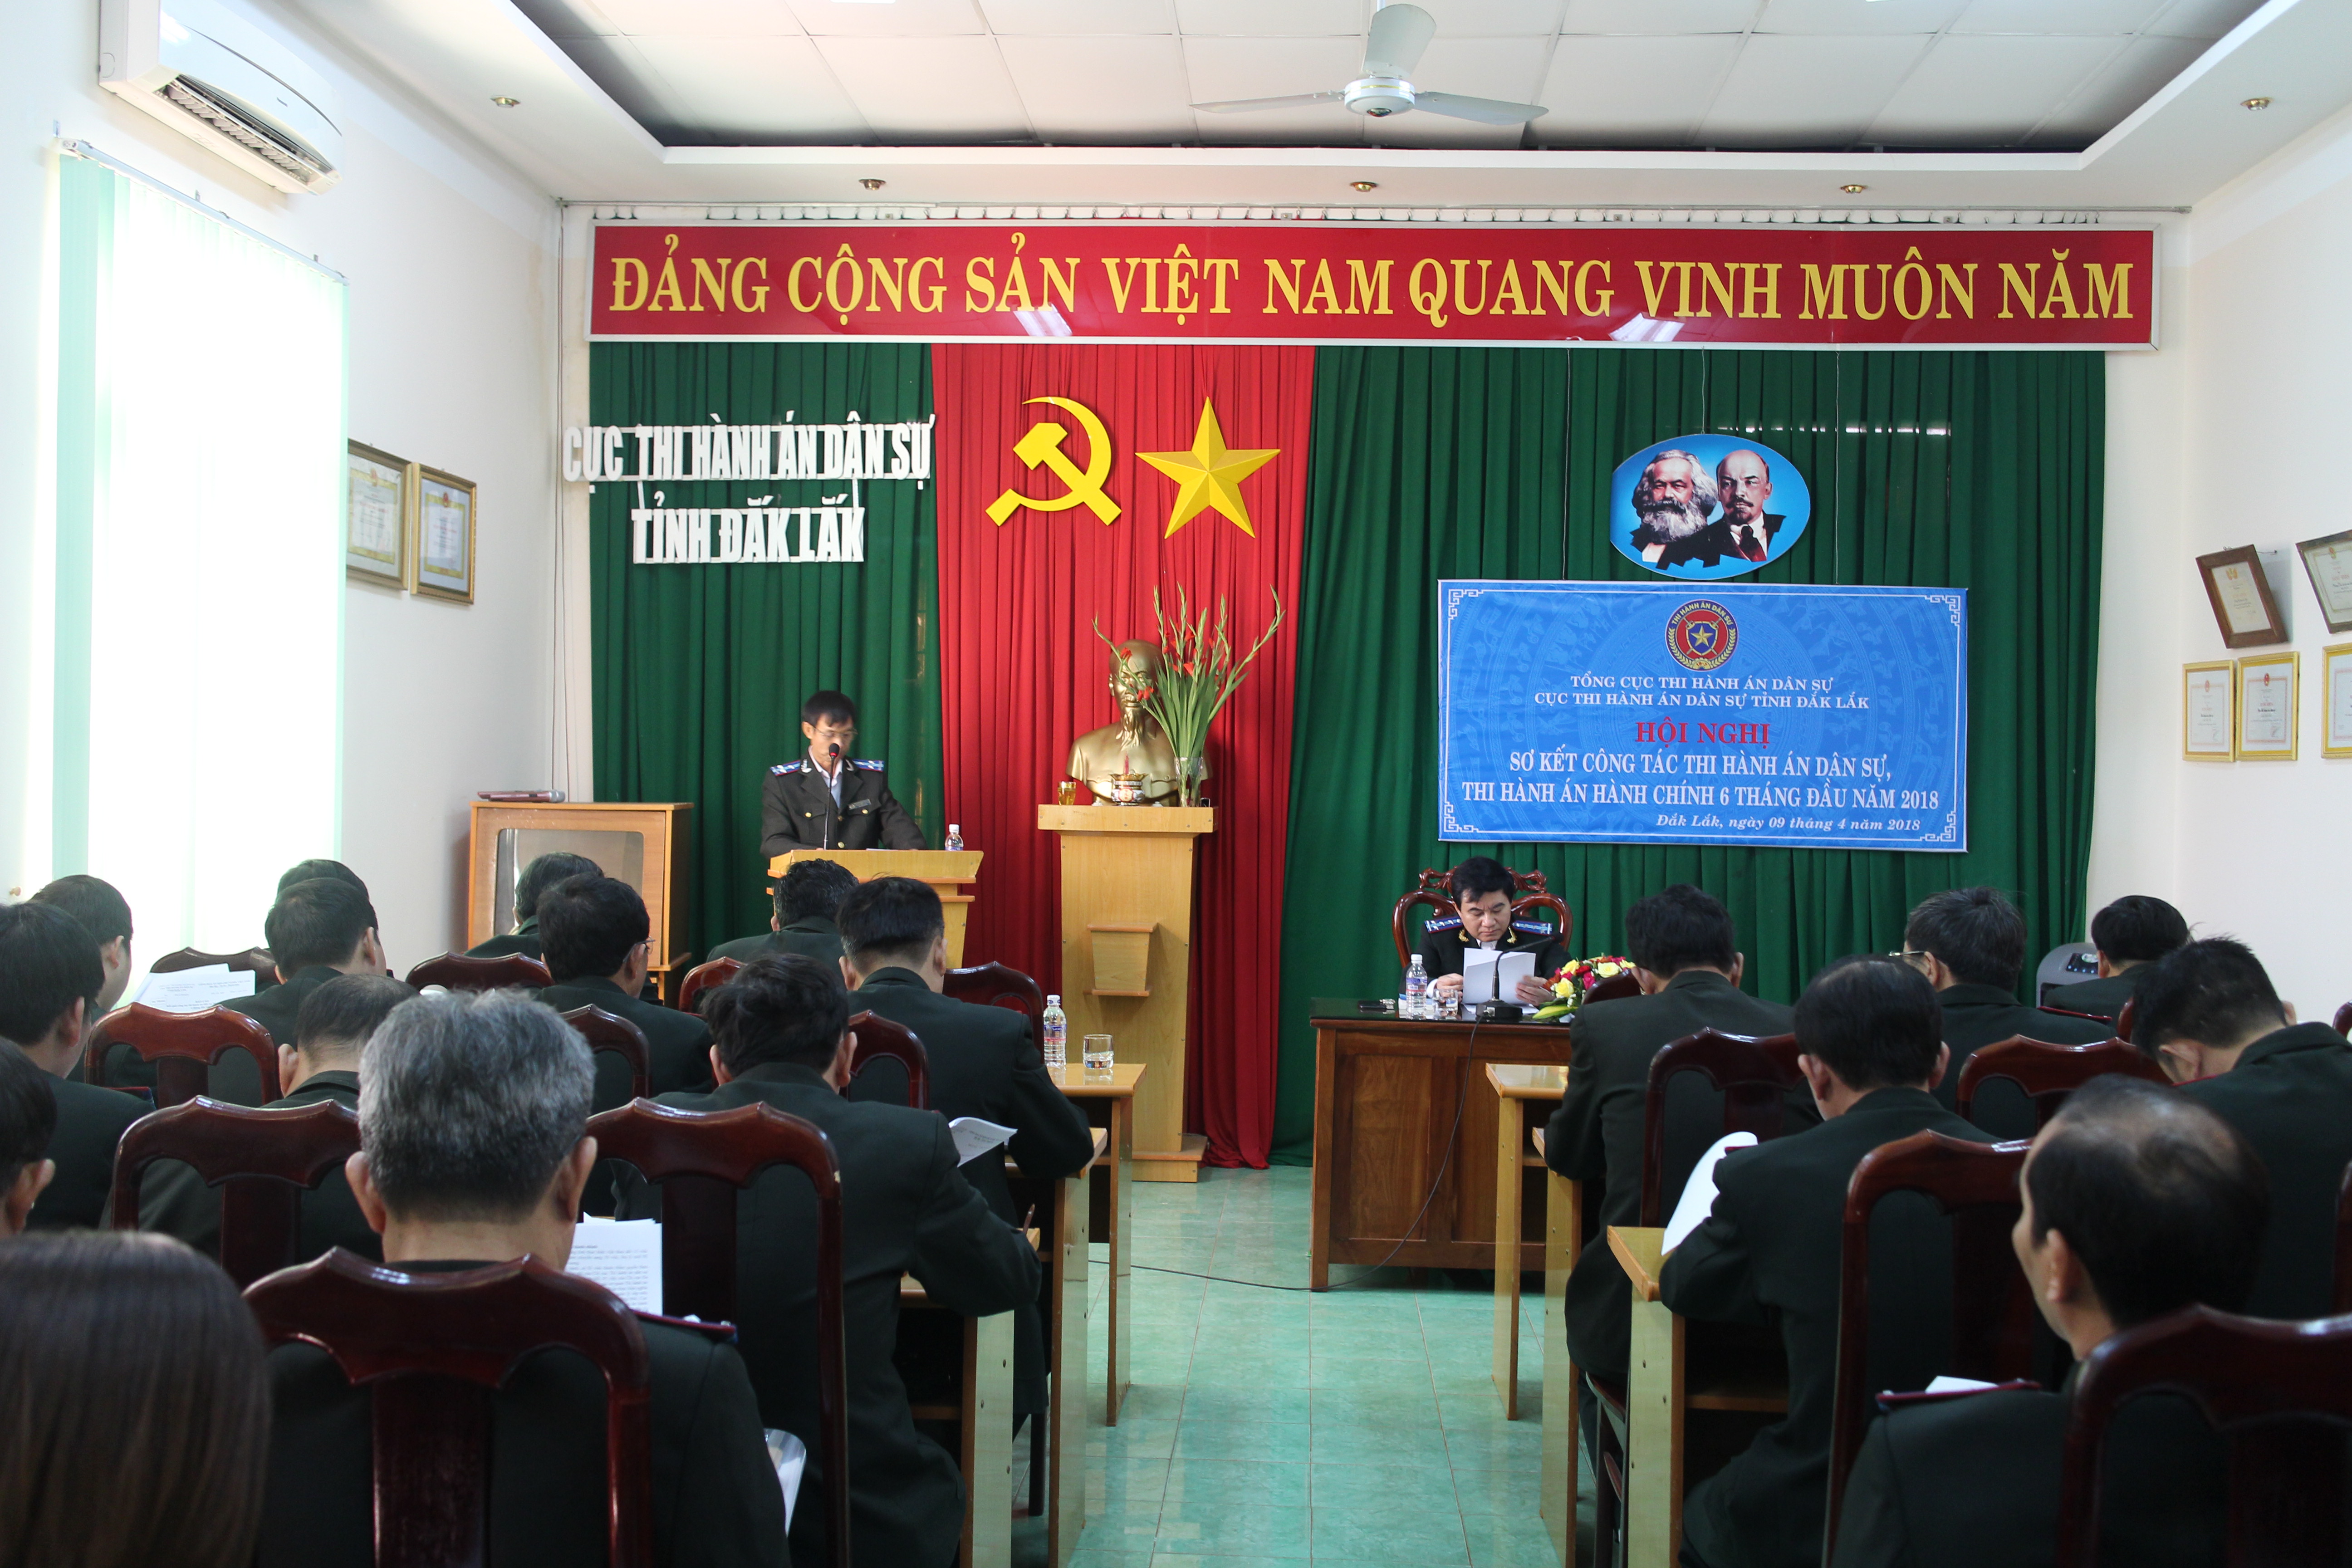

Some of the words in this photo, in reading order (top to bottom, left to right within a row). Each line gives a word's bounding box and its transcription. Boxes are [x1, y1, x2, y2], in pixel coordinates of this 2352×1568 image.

[609, 233, 769, 313] ĐẢNG
[788, 244, 947, 326] CỘNG
[965, 232, 1081, 314] SẢN
[1101, 244, 1239, 326] VIỆT
[1263, 258, 1394, 315] NAM
[1409, 258, 1614, 328] QUANG
[1634, 261, 1782, 318] VINH
[1799, 246, 1978, 320] MUÔN
[1998, 248, 2133, 319] NĂM
[562, 426, 623, 494] CỤC
[635, 424, 683, 480] THI
[691, 412, 771, 480] HÀNH
[777, 411, 817, 480] ÁN
[823, 411, 884, 480] DÂN
[891, 414, 935, 490] SỰ
[631, 491, 710, 563] TỈNH
[719, 495, 791, 563] ĐẮK
[799, 493, 865, 562] LẮK
[1671, 613, 1681, 625] THI
[1680, 603, 1699, 615] HÀNH
[1712, 605, 1726, 616] DÂN
[1570, 671, 1615, 688] TỔNG
[1620, 677, 1654, 691] CỤC
[1658, 677, 1687, 689] THI
[1691, 674, 1739, 689] HÀNH
[1744, 675, 1768, 690] ÁN
[1772, 676, 1807, 691] DÂN
[1811, 677, 1833, 694] SỰ
[1534, 692, 1568, 706] CỤC
[1573, 693, 1601, 705] THI
[1606, 691, 1653, 705] HÀNH
[1657, 691, 1681, 706] ÁN
[1686, 692, 1720, 706] DÂN
[1725, 693, 1747, 709] SỰ
[1751, 691, 1791, 707] TỈNH
[1796, 691, 1831, 708] ĐẮK
[1836, 691, 1869, 709] LẮK
[1635, 716, 1689, 748] HỘI
[1697, 723, 1770, 749] NGHỊ
[1510, 749, 1534, 771] SƠ
[1539, 744, 1578, 772] KẾT
[1582, 748, 1635, 773] CÔNG
[1641, 748, 1678, 774] TÁC
[1683, 755, 1716, 774] THI
[1722, 750, 1778, 775] HÀNH
[1783, 750, 1811, 776] ÁN
[1815, 751, 1856, 777] DÂN
[1861, 754, 1891, 782] SỰ,
[1462, 782, 1495, 801] THI
[1500, 777, 1555, 803] HÀNH
[1559, 777, 1588, 803] ÁN
[1592, 778, 1647, 804] HÀNH
[1653, 779, 1715, 806] CHÍNH
[1720, 787, 1729, 806] 6
[1735, 781, 1801, 808] THÁNG
[1807, 777, 1847, 808] ĐẦU
[1852, 784, 1896, 809] NĂM
[1901, 790, 1939, 810] 2018
[1656, 813, 1687, 827] Đắk
[1691, 813, 1724, 829] Lắk,
[1729, 817, 1764, 830] ngày
[1769, 818, 1785, 828] 09
[1790, 817, 1834, 831] tháng
[1837, 819, 1846, 830] 4
[1851, 819, 1883, 830] năm
[1887, 820, 1921, 831] 2018
